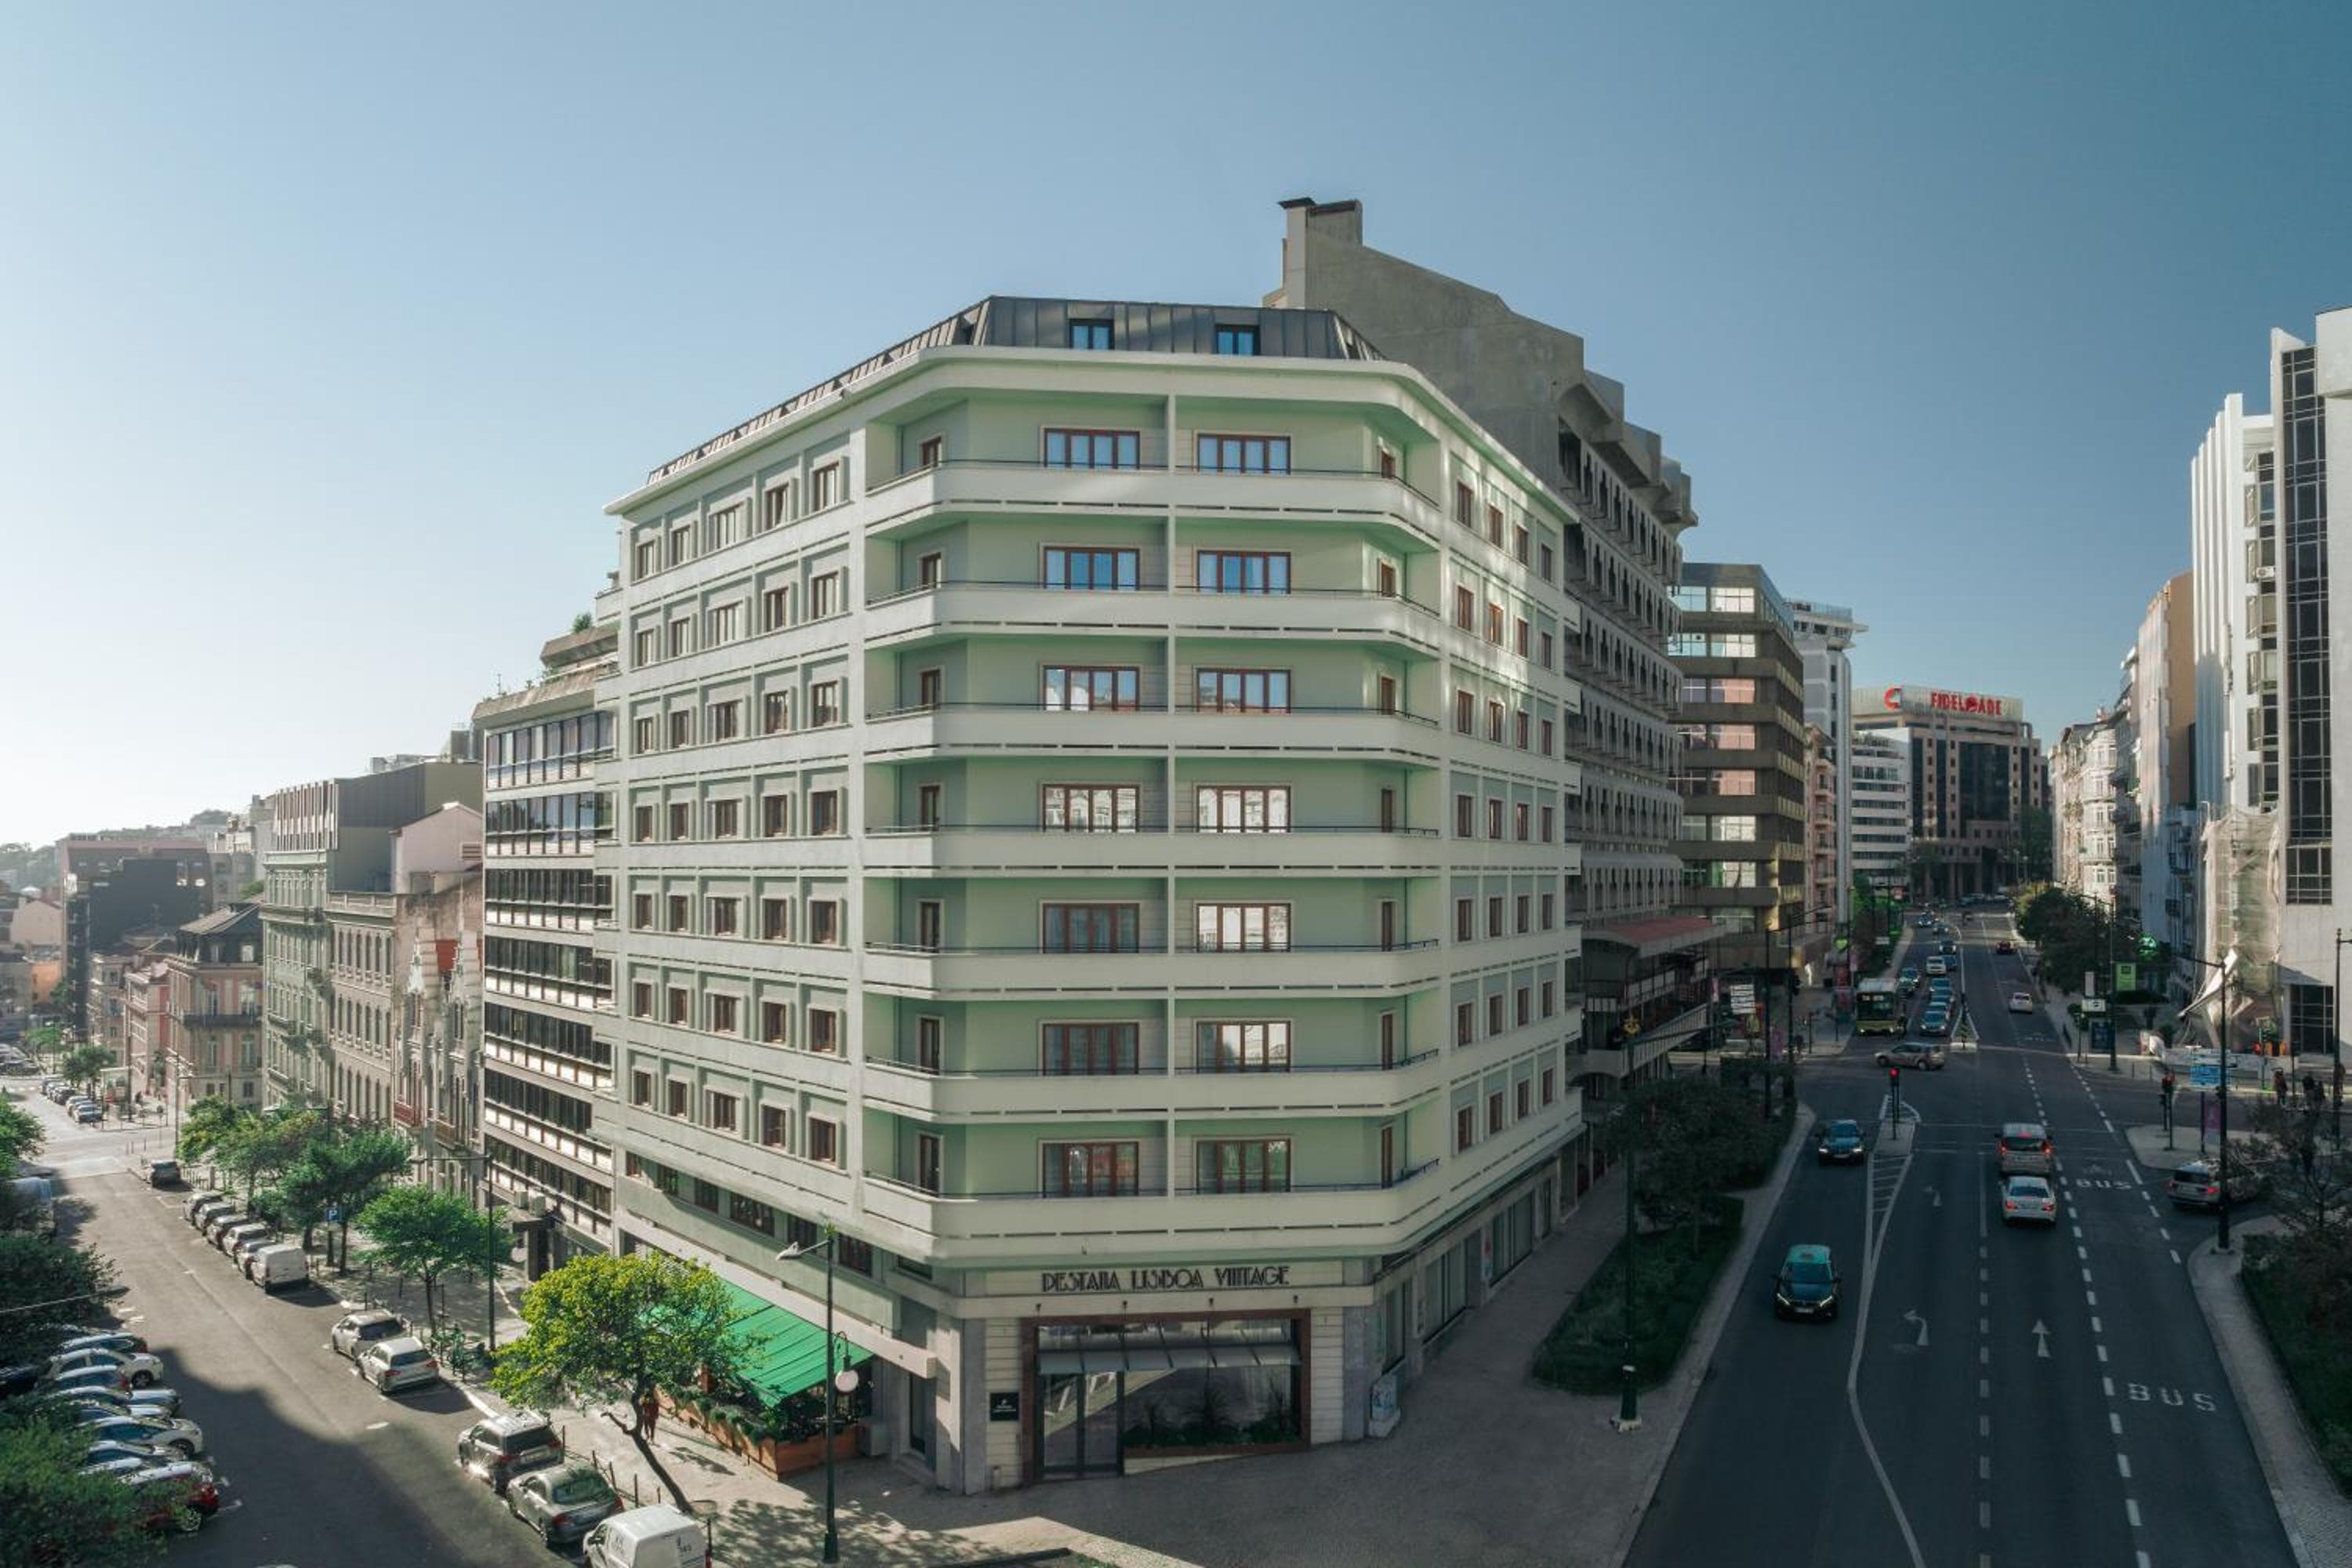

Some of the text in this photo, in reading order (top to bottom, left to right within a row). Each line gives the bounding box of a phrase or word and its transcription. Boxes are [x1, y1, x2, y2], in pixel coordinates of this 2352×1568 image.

[1931, 692, 2002, 715] FIDELADE
[2075, 1178, 2132, 1190] BUS
[328, 1210, 338, 1220] P
[1042, 1265, 1290, 1293] PESTANA LISBOA VINTAGE
[2127, 1382, 2216, 1411] BUS
